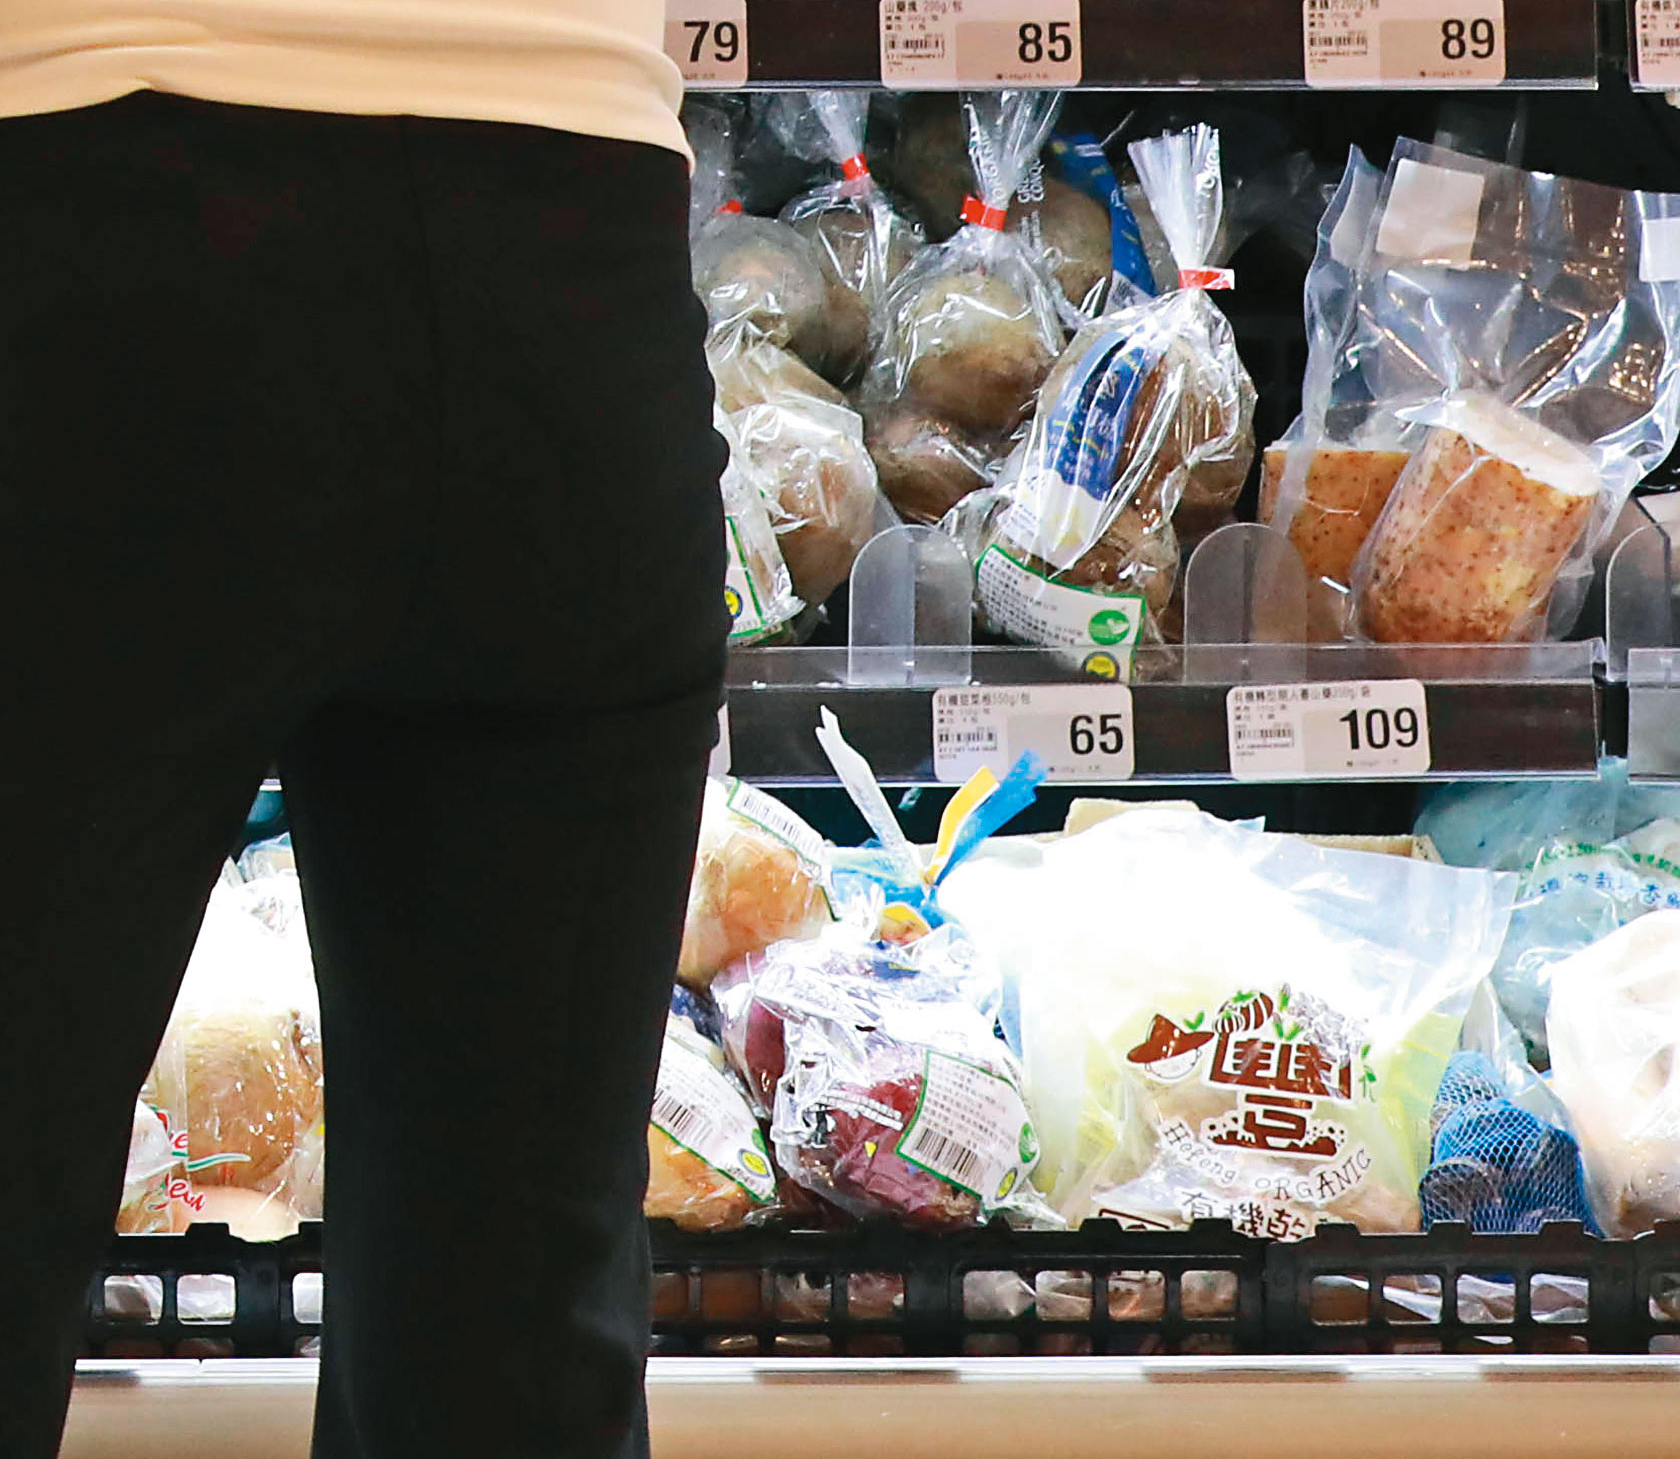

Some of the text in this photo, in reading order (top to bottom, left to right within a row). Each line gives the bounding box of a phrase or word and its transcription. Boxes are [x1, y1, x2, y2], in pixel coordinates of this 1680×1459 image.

[684, 21, 738, 62] 79
[1019, 22, 1071, 63] 85
[1442, 19, 1494, 59] 89
[1071, 714, 1123, 754] 65
[1340, 708, 1418, 749] 109
